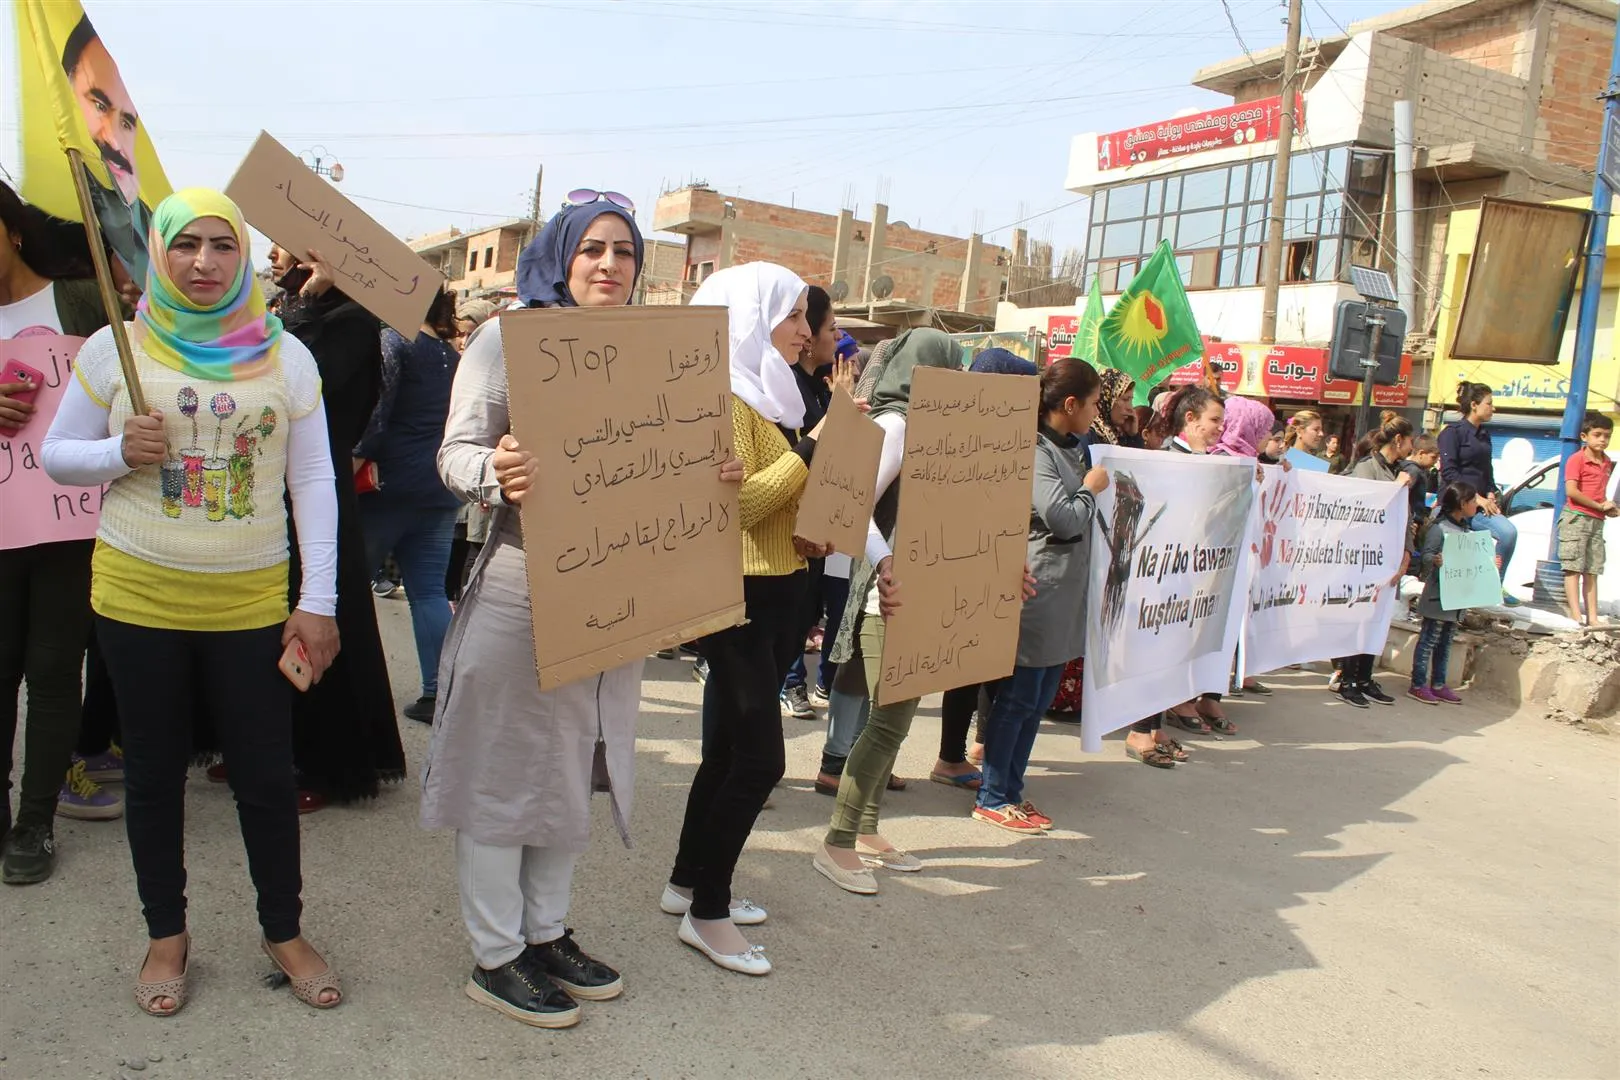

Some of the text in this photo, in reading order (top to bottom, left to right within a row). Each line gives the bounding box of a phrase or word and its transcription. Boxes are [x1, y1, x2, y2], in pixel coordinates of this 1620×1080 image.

[1124, 107, 1263, 150] مجمع ومقهى بوابة دمشق
[274, 179, 329, 230] بالنساء
[666, 330, 721, 383] أوقفوا
[1269, 360, 1317, 381] بوابة
[1521, 376, 1570, 405] كتبة
[563, 393, 726, 464] العنف الجنسي والنفسي
[959, 434, 982, 458] المرأة
[573, 430, 730, 504] والجسدي والاقتصادي
[996, 459, 1018, 483] الرجل
[1018, 464, 1031, 481] مع
[1290, 493, 1307, 518] Na
[1303, 495, 1316, 527] ji
[1313, 493, 1352, 527] kuştina
[1348, 500, 1375, 529] jinan
[909, 520, 1025, 576] نعم للمساواة
[1136, 545, 1159, 578] Na
[1157, 544, 1174, 584] ji
[1171, 543, 1189, 574] bo
[1277, 539, 1293, 563] Na
[1291, 541, 1305, 572] ji
[1335, 540, 1344, 564] li
[1343, 548, 1359, 565] ser
[1361, 543, 1384, 574] jinê
[941, 583, 1016, 629] مع الرجل
[1138, 593, 1191, 635] kuştina
[884, 651, 920, 688] المرأة
[957, 633, 980, 673] نعم
